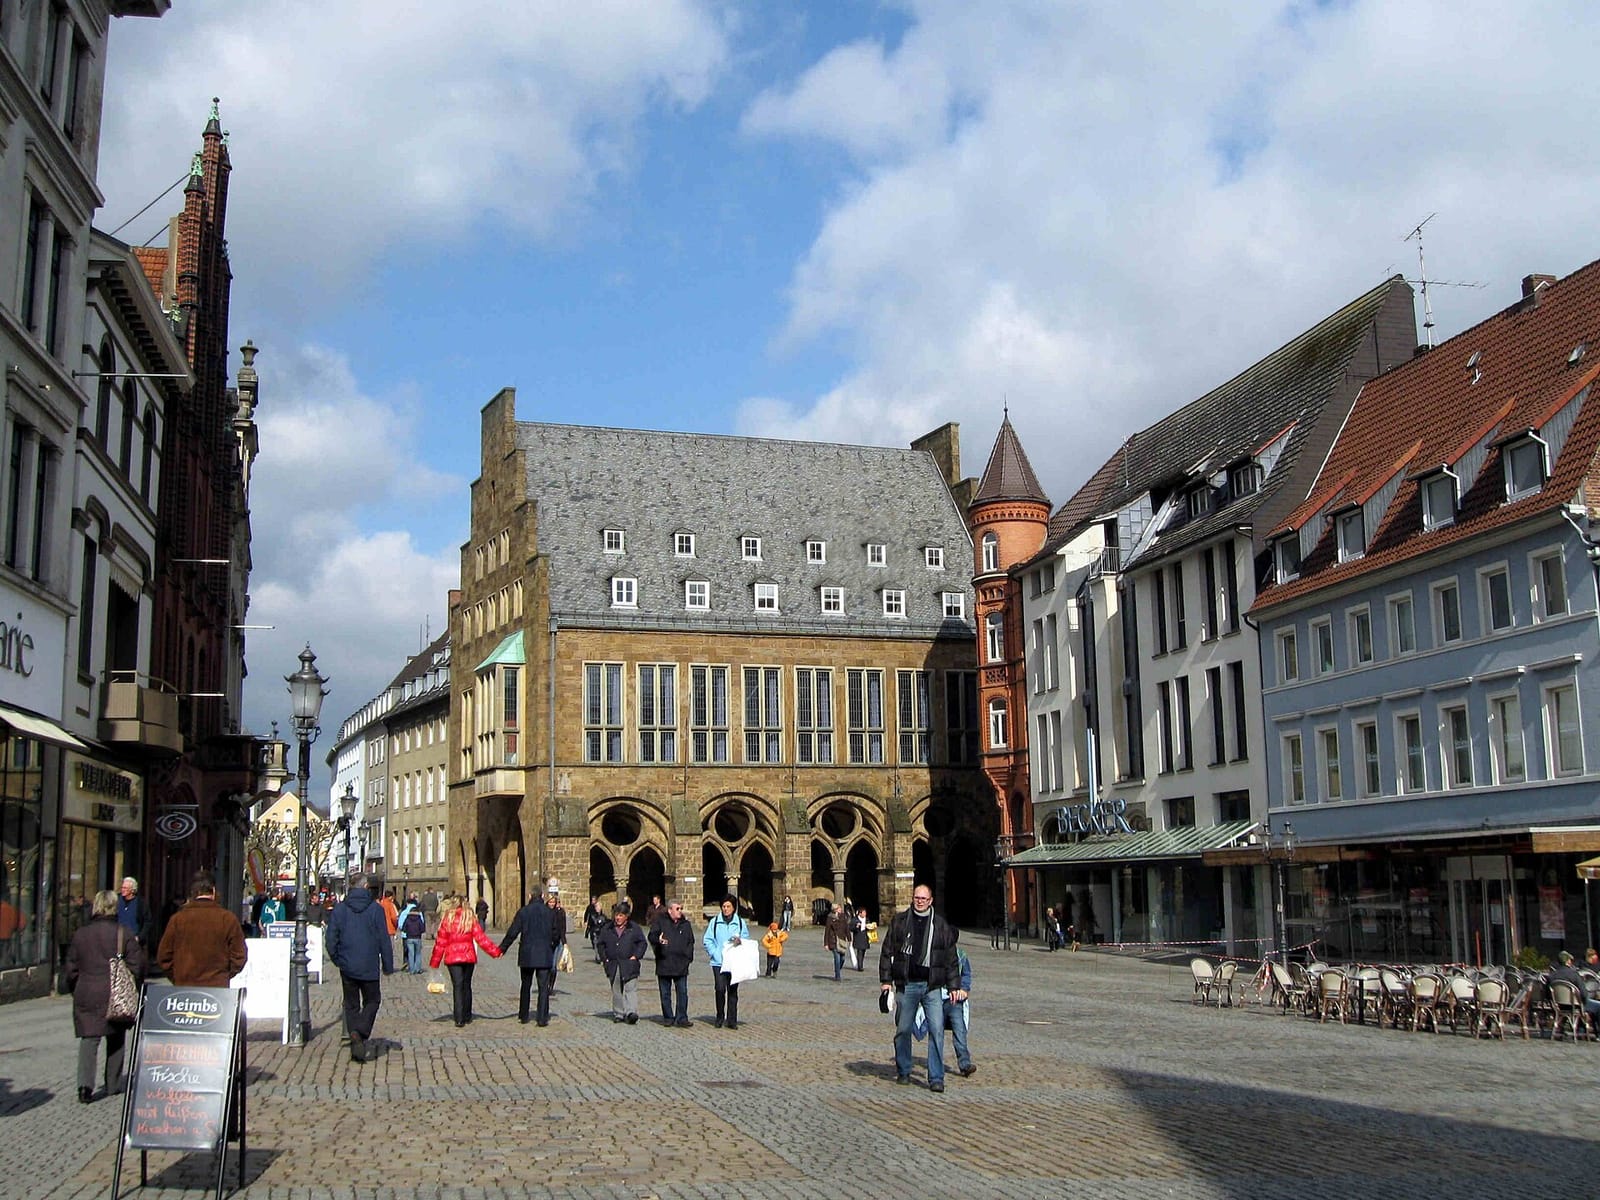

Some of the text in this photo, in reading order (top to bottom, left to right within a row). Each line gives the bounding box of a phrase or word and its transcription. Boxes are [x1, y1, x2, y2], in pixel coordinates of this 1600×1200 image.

[1057, 799, 1136, 835] BECKER
[166, 998, 218, 1012] Heimbs
[174, 1016, 203, 1025] KAFFEE
[148, 1065, 200, 1083] Frische
